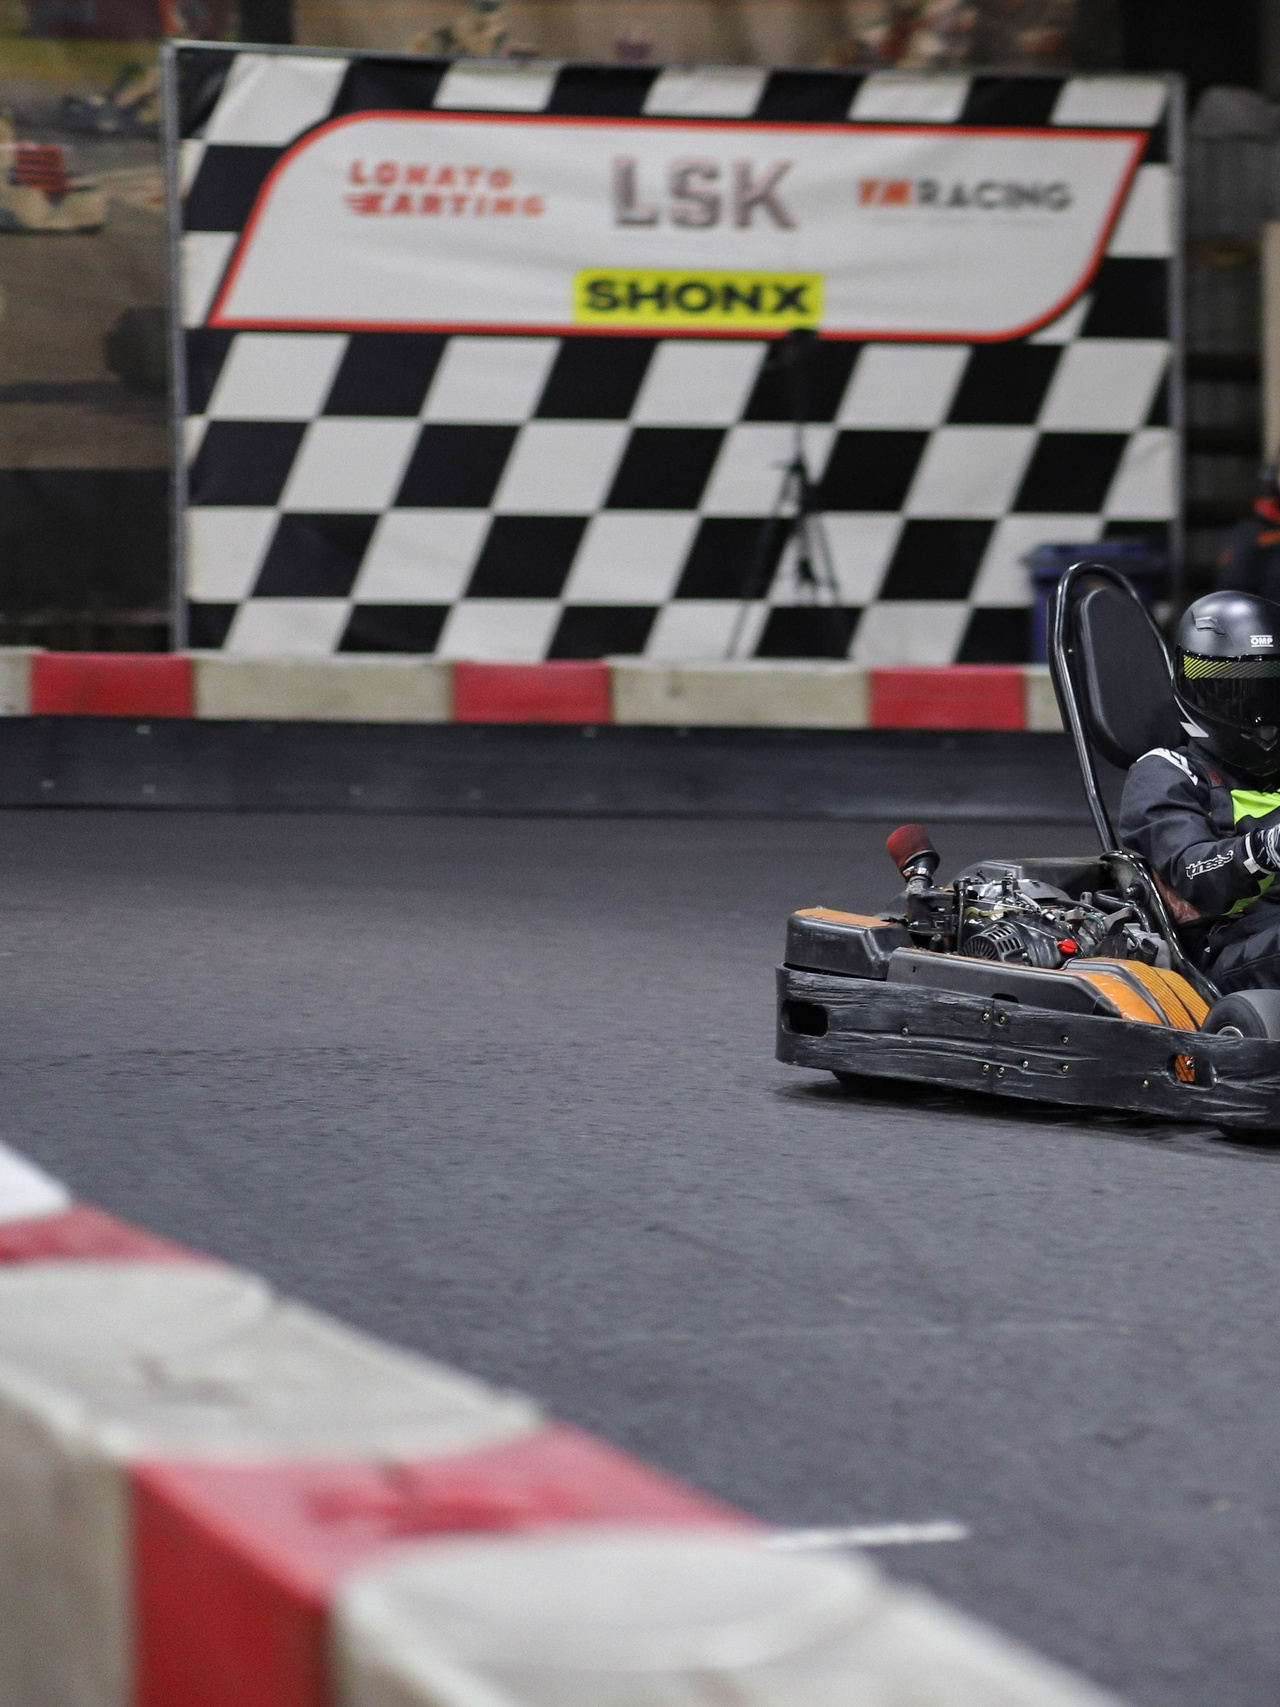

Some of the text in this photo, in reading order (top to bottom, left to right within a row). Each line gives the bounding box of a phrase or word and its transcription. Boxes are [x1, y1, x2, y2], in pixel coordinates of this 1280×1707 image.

[349, 158, 515, 189] LONATO
[611, 155, 797, 231] LSK
[917, 178, 1073, 211] RACING
[584, 279, 810, 316] SHONX
[1250, 636, 1273, 646] OMP
